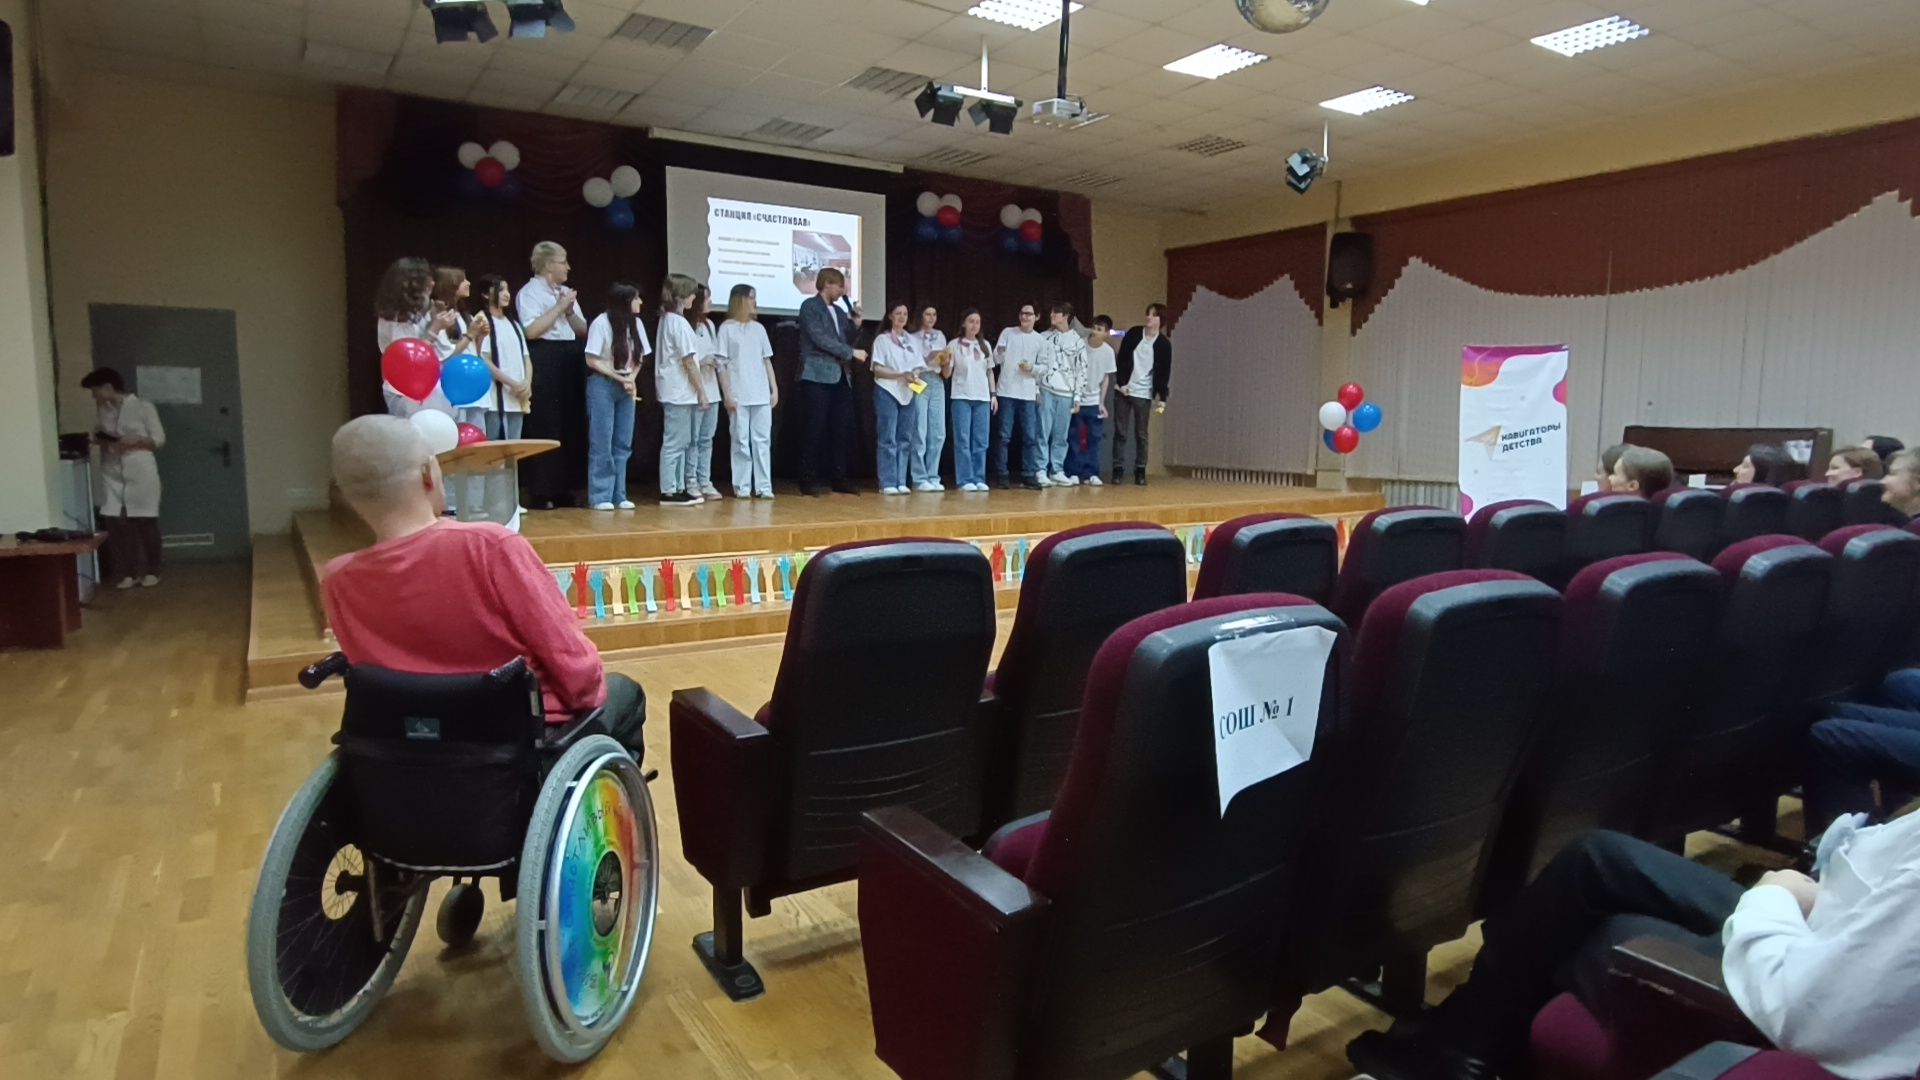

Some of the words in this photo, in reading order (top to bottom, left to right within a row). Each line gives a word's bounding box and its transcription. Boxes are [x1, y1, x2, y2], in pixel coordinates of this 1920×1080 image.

[714, 208, 752, 221] СТАНЦИЯ
[1502, 423, 1561, 442] НАВИГАТОРЫ
[1502, 438, 1542, 453] ДЕТСТВА
[1220, 704, 1256, 740] СОШ
[1259, 700, 1280, 723] №
[1286, 696, 1295, 717] 1
